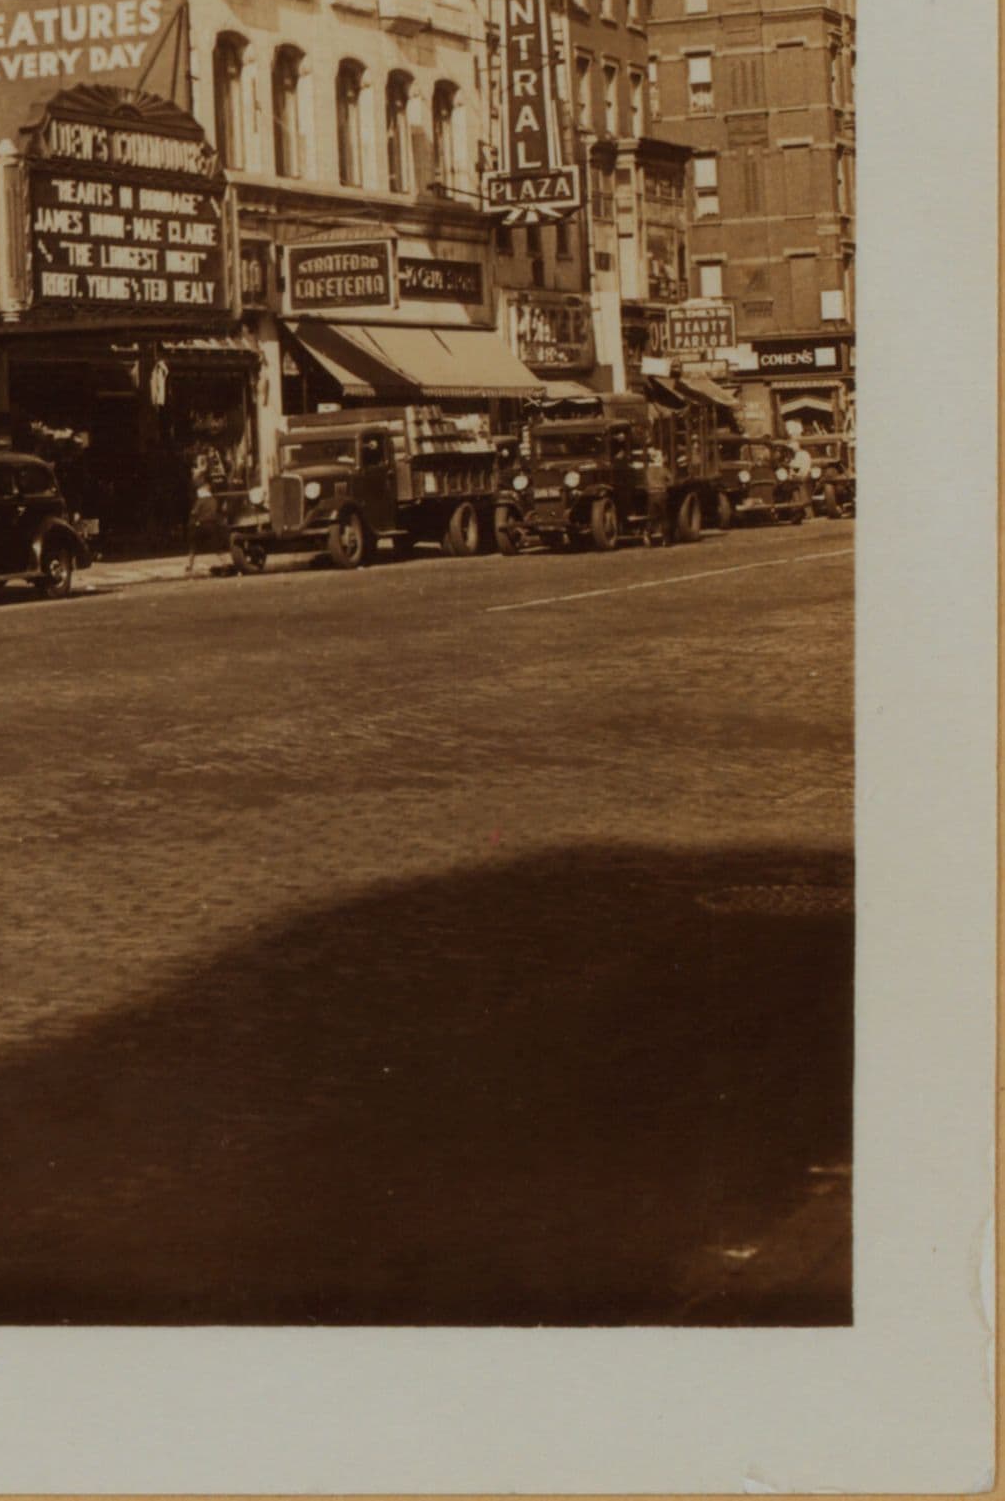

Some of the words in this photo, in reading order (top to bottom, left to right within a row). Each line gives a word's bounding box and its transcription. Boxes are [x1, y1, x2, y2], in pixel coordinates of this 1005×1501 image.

[89, 41, 149, 72] DAY
[490, 177, 572, 201] PLAZA
[34, 208, 83, 234] JAMES
[167, 220, 216, 246] CLARKE
[298, 253, 380, 274] STRATFORD
[142, 278, 168, 301] TED
[173, 281, 216, 304] HEALY
[295, 273, 386, 299] CAFETERIA
[674, 320, 727, 334] BEAUTY
[674, 334, 728, 348] PARLOR
[760, 350, 814, 367] COHEN'S
